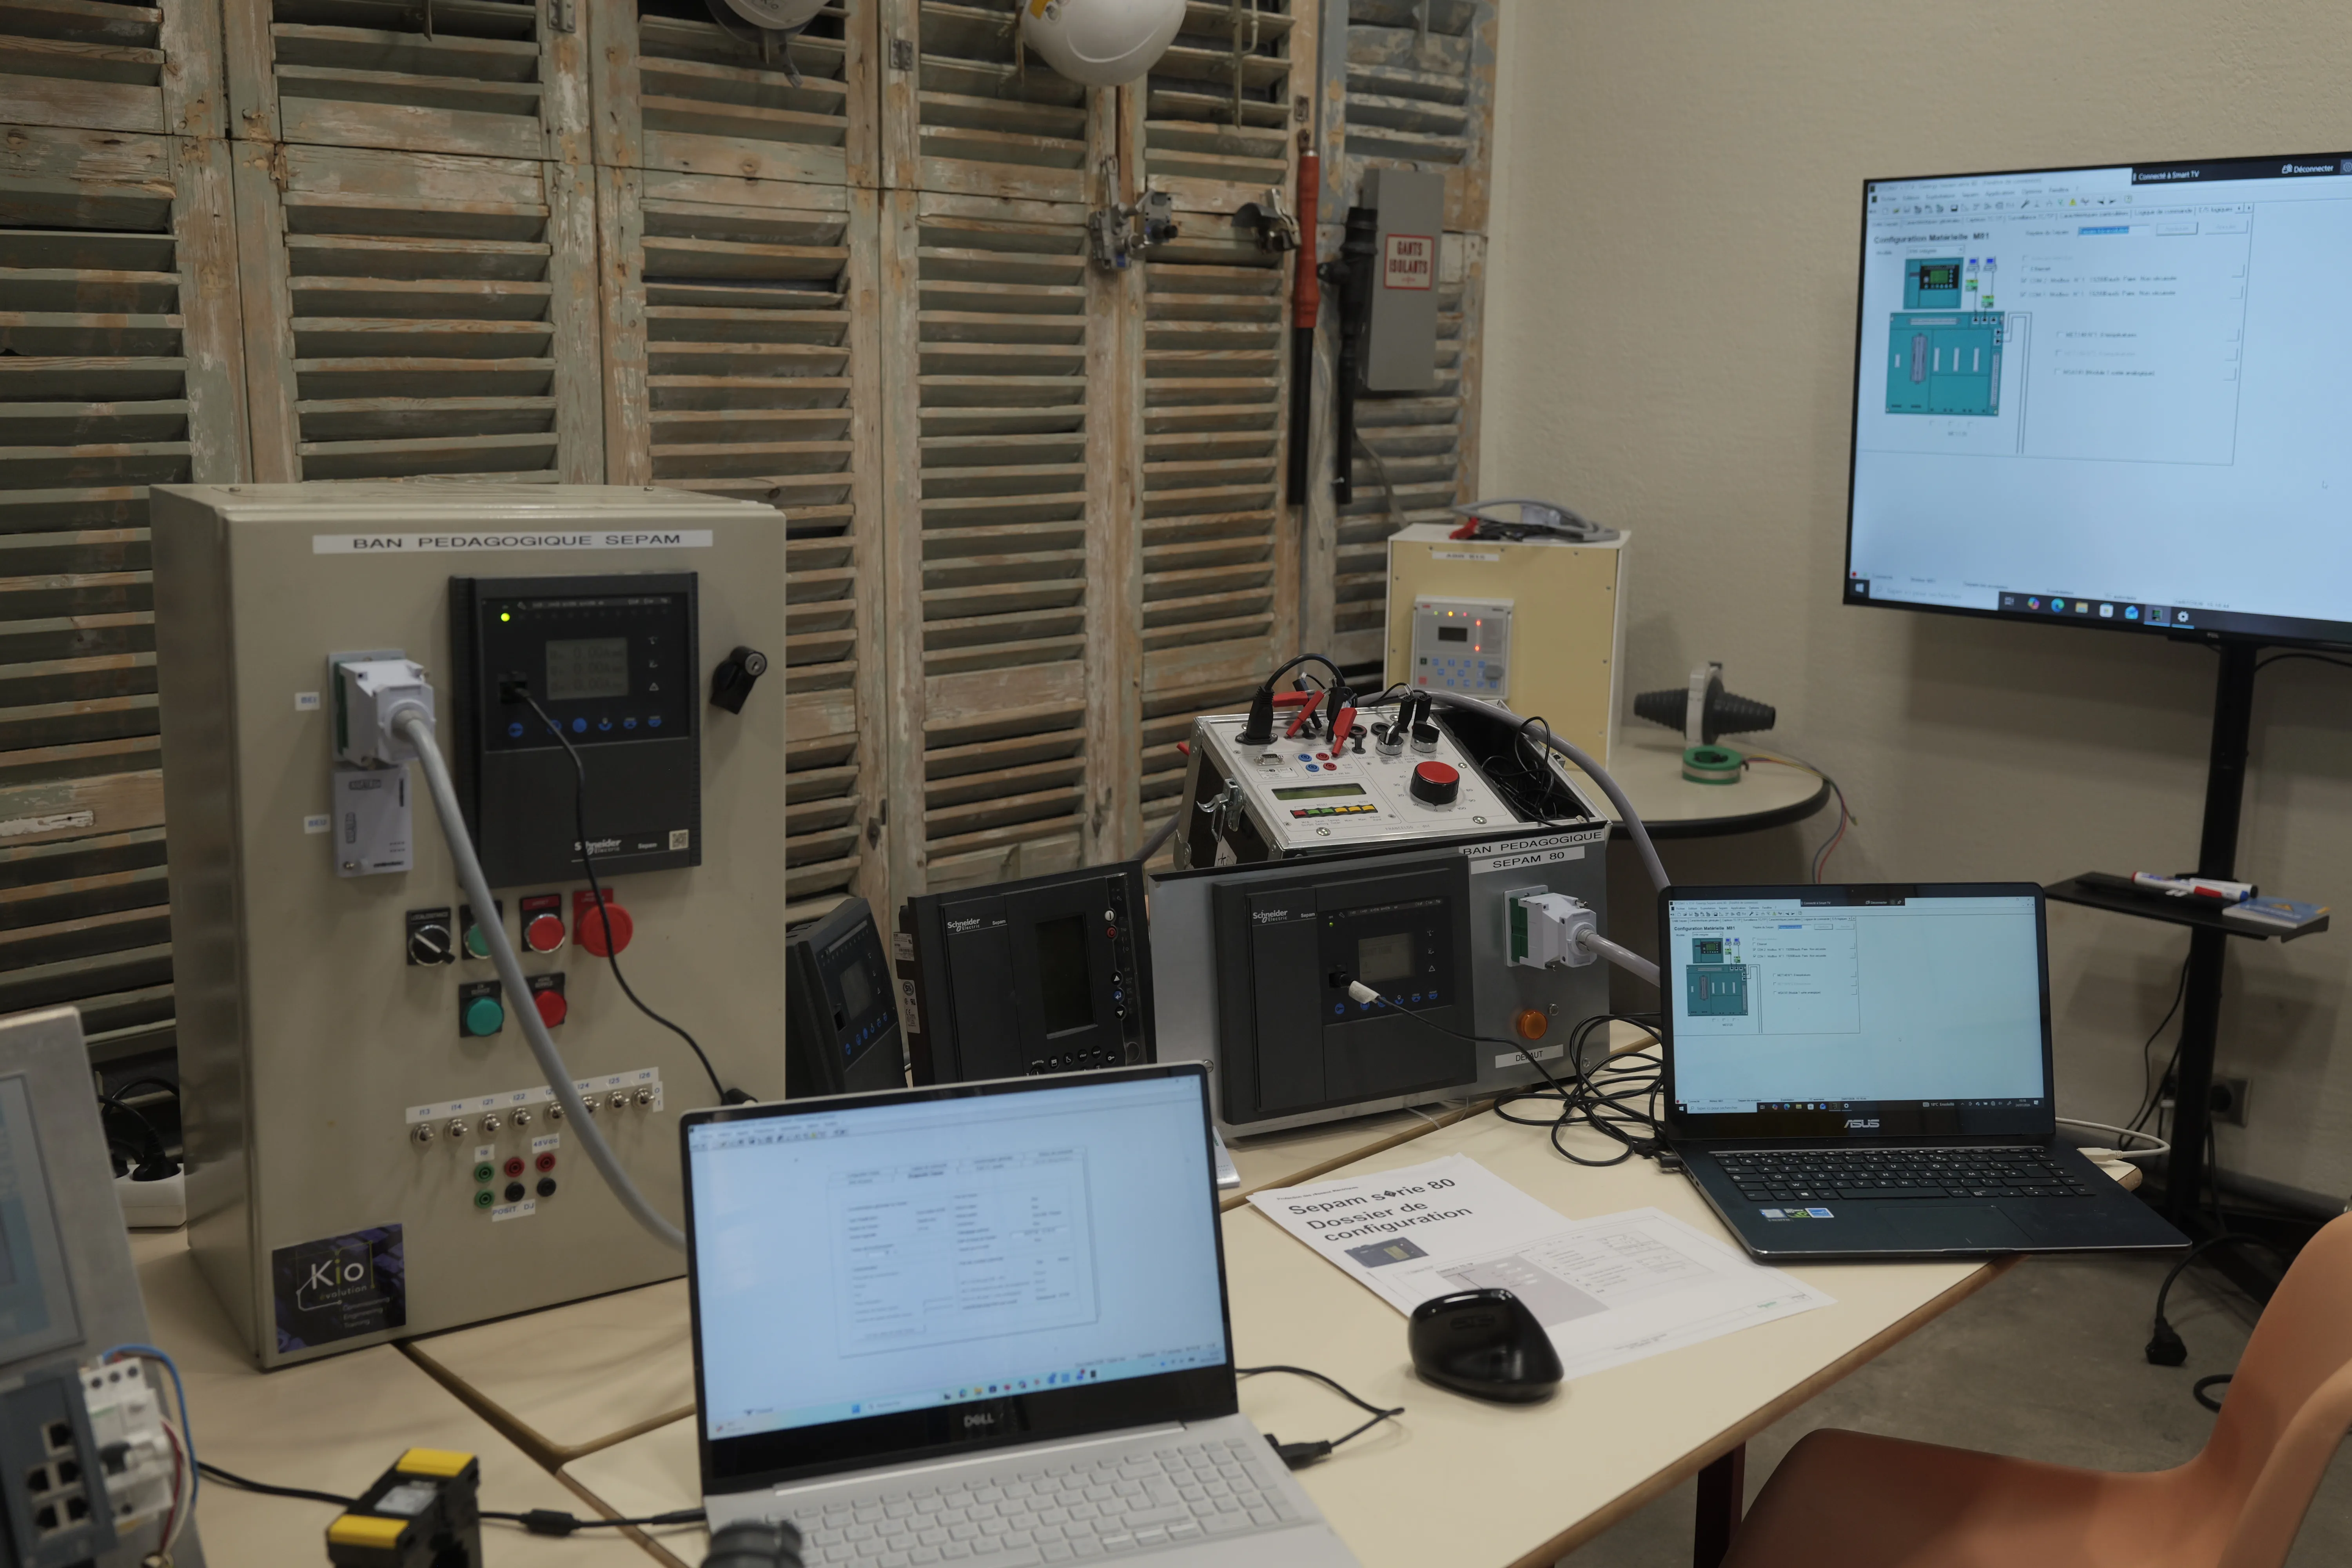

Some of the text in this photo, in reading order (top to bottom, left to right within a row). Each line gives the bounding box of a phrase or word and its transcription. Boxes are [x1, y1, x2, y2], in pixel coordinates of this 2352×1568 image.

[2172, 171, 2190, 179] Smart
[1397, 241, 1423, 256] GANTS
[1389, 259, 1428, 275] ISOLANTS
[353, 533, 681, 549] BAN PEDAGOGIQUE SEPAM
[575, 838, 622, 851] Shneider
[1463, 831, 1602, 855] BAN PEDAGOGIQUE
[1492, 851, 1565, 869] SEPAM 80
[1253, 909, 1288, 920] Schneider
[947, 918, 980, 929] Schneider
[1515, 1051, 1544, 1062] DEAUT
[1844, 1119, 1880, 1128] ASUS
[1288, 1195, 1369, 1215] Sepam
[1426, 1178, 1455, 1189] 80
[1306, 1202, 1428, 1231] Dossier de
[1325, 1207, 1473, 1241] configuration
[311, 1258, 365, 1290] Kio
[964, 1414, 994, 1428] DELL
